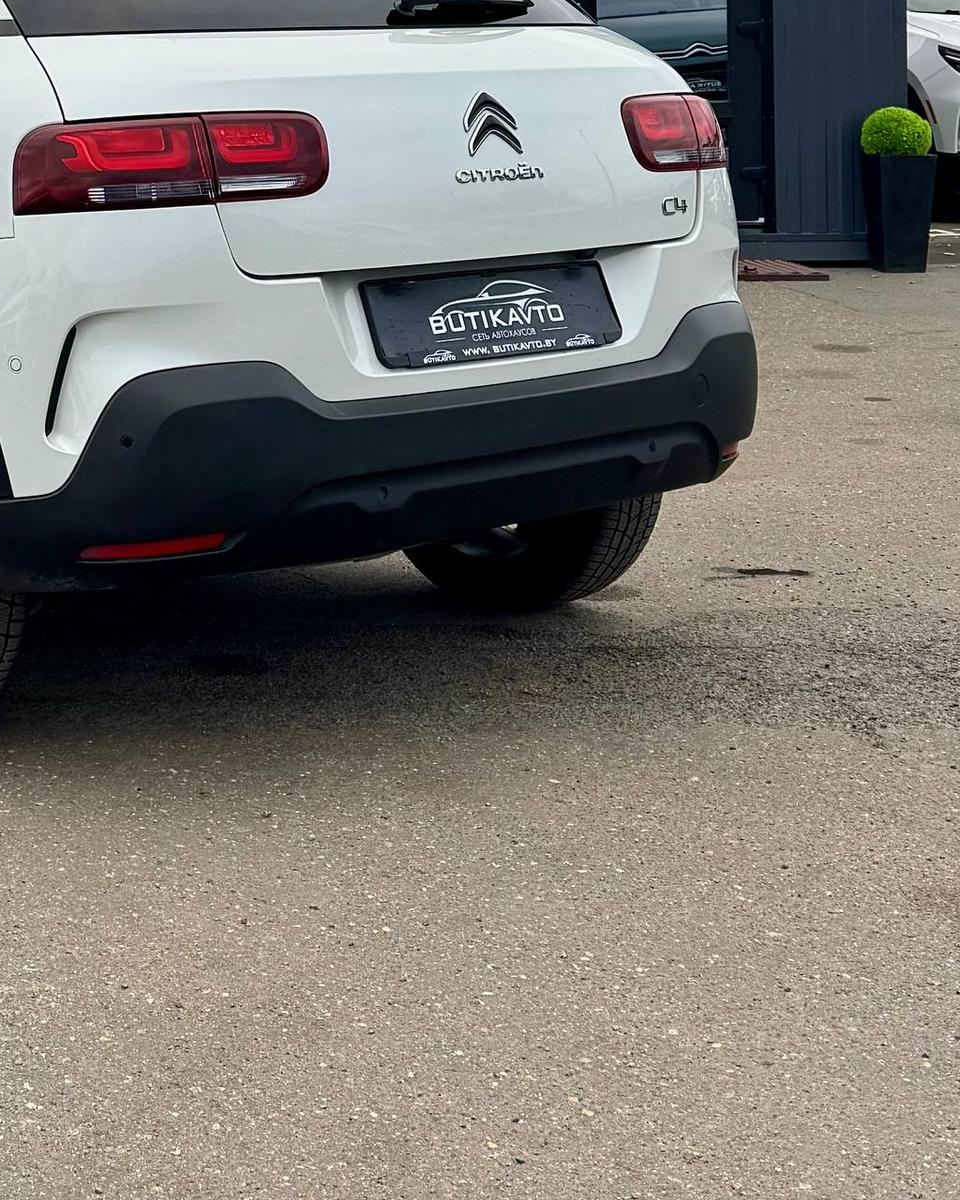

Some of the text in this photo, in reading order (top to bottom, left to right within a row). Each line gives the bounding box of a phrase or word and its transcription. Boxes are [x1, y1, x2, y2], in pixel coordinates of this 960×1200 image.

[661, 196, 688, 216] C4
[428, 304, 565, 335] BUTIKAVTO
[471, 327, 537, 342] СЕТЬ АВТОХАУСОВ
